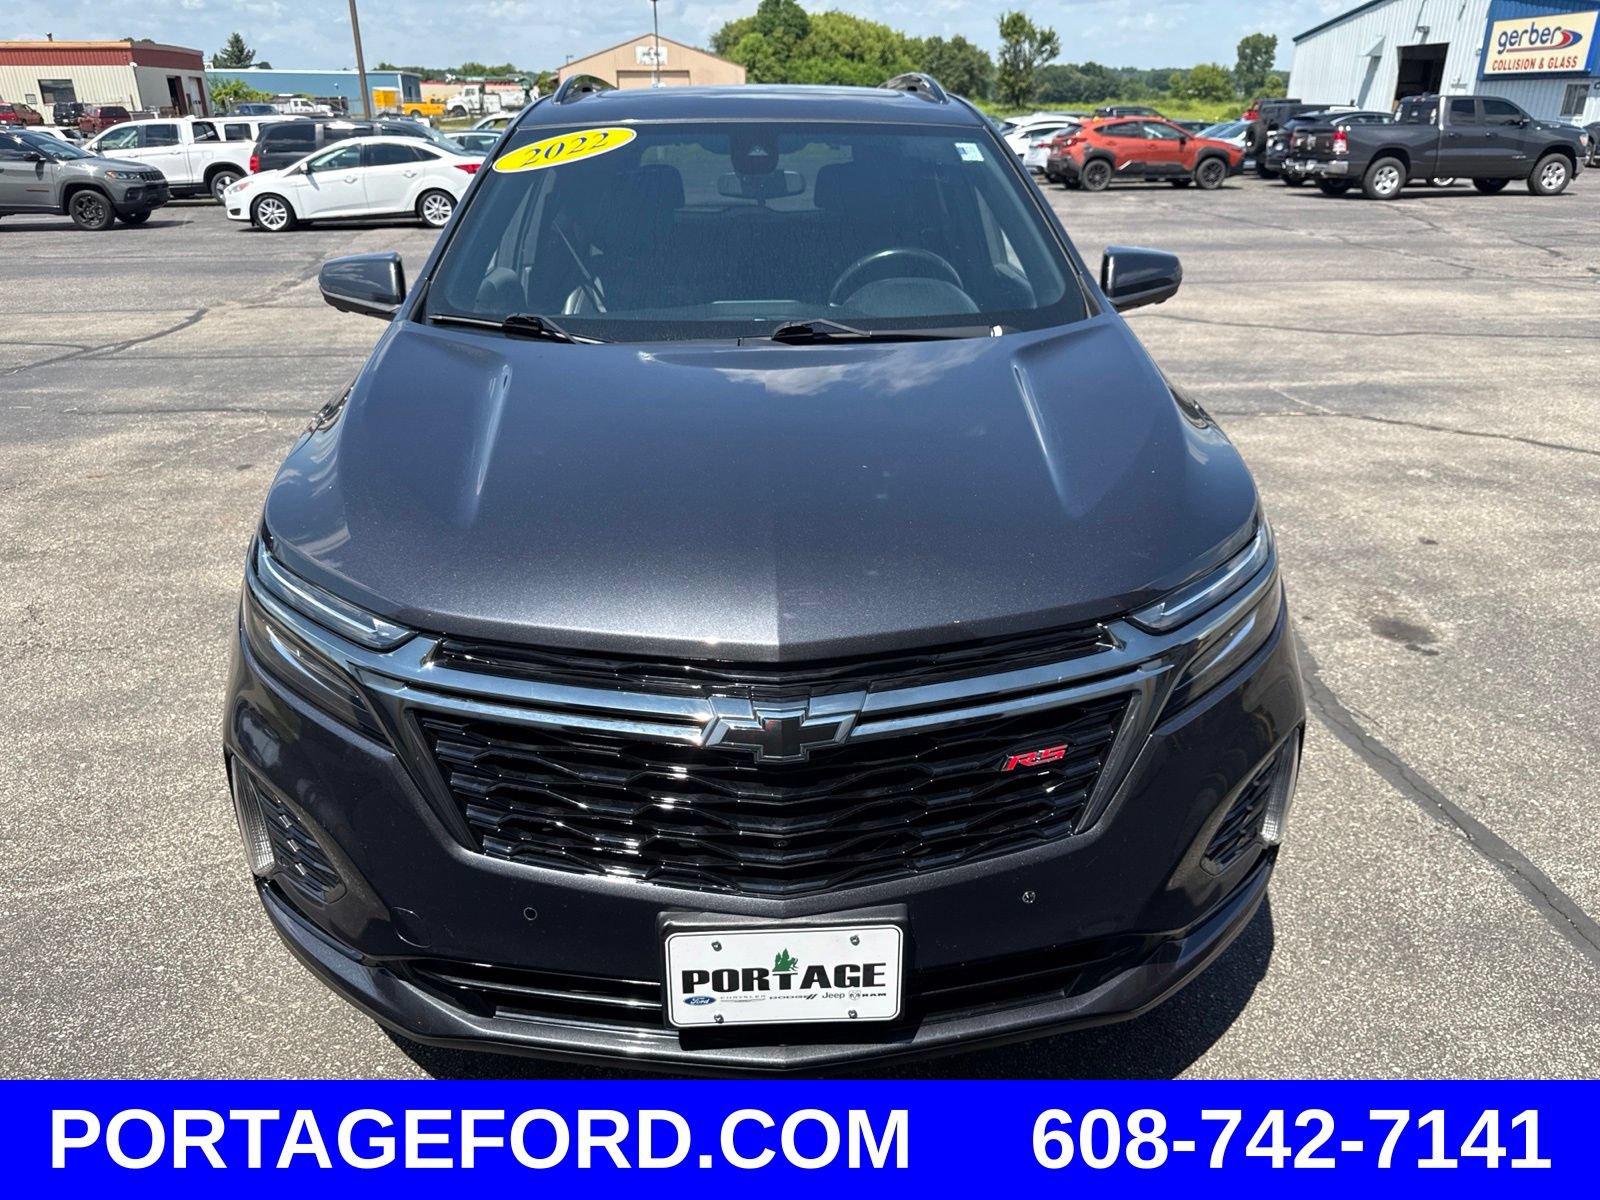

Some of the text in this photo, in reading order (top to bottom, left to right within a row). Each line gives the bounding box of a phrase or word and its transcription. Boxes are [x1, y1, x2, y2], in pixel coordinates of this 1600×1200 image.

[1497, 21, 1562, 55] gerber
[1492, 55, 1578, 71] COLLISION & GLASS
[519, 132, 609, 167] 2022
[1001, 744, 1068, 771] RS
[682, 962, 887, 994] PORTAGE
[822, 992, 846, 1000] Jeep
